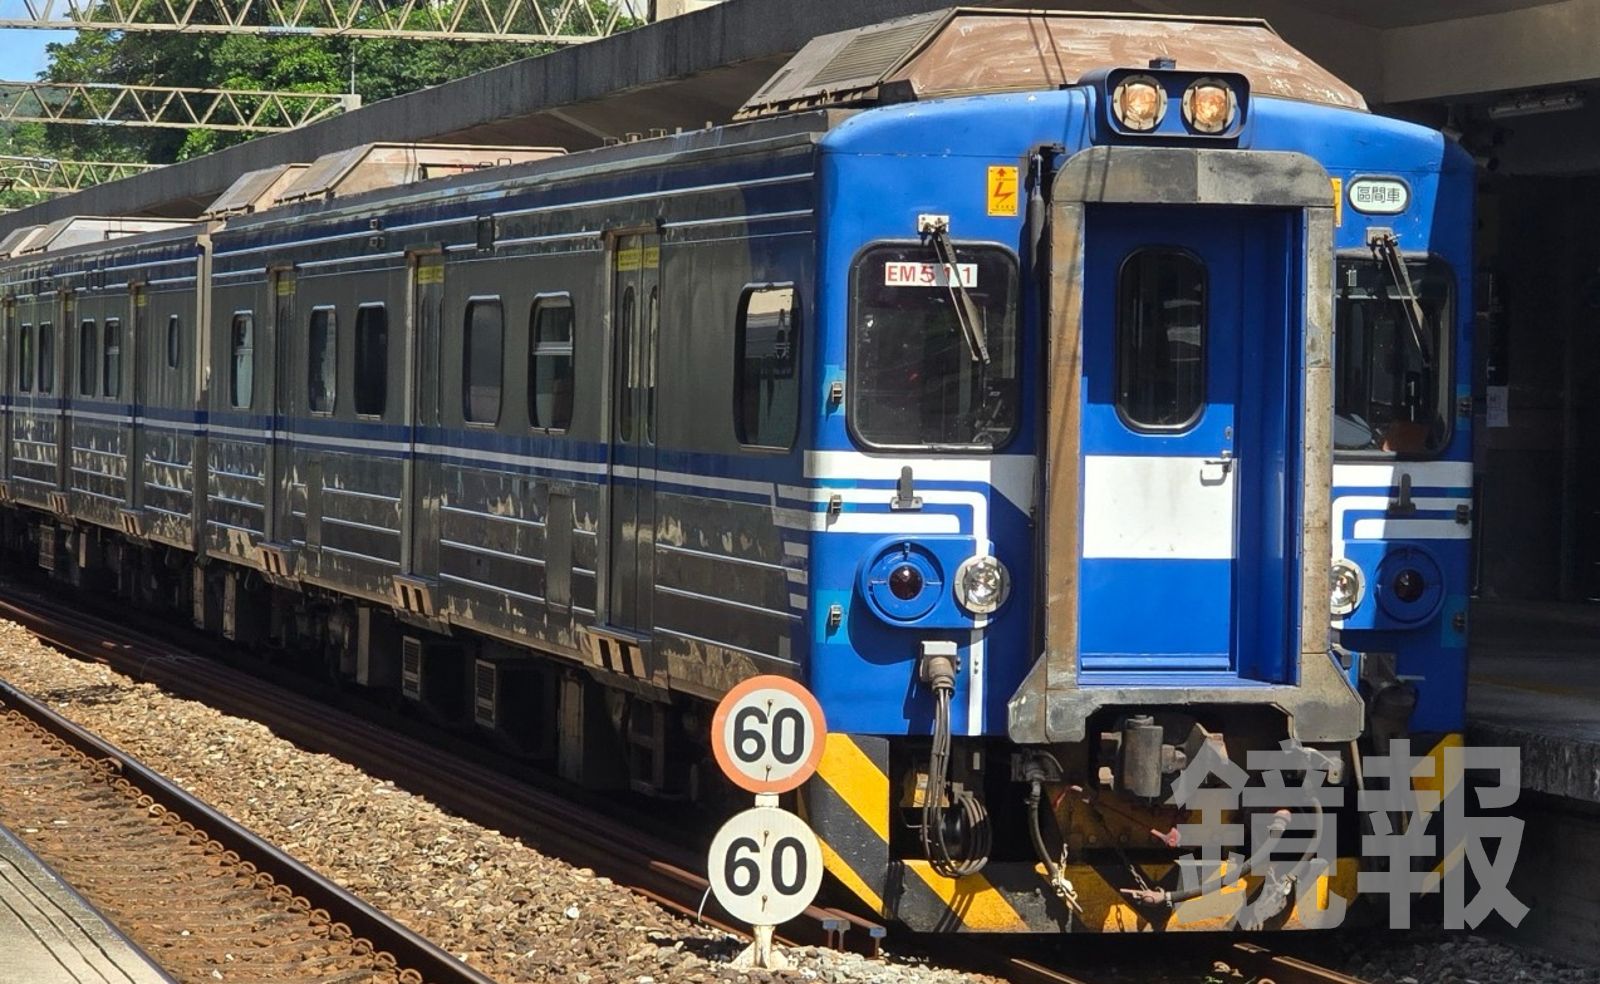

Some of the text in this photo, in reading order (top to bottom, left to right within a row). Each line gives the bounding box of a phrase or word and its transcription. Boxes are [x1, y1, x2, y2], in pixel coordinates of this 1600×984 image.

[1357, 186, 1400, 203] 區間車
[733, 706, 805, 764] 60
[724, 836, 807, 897] 60
